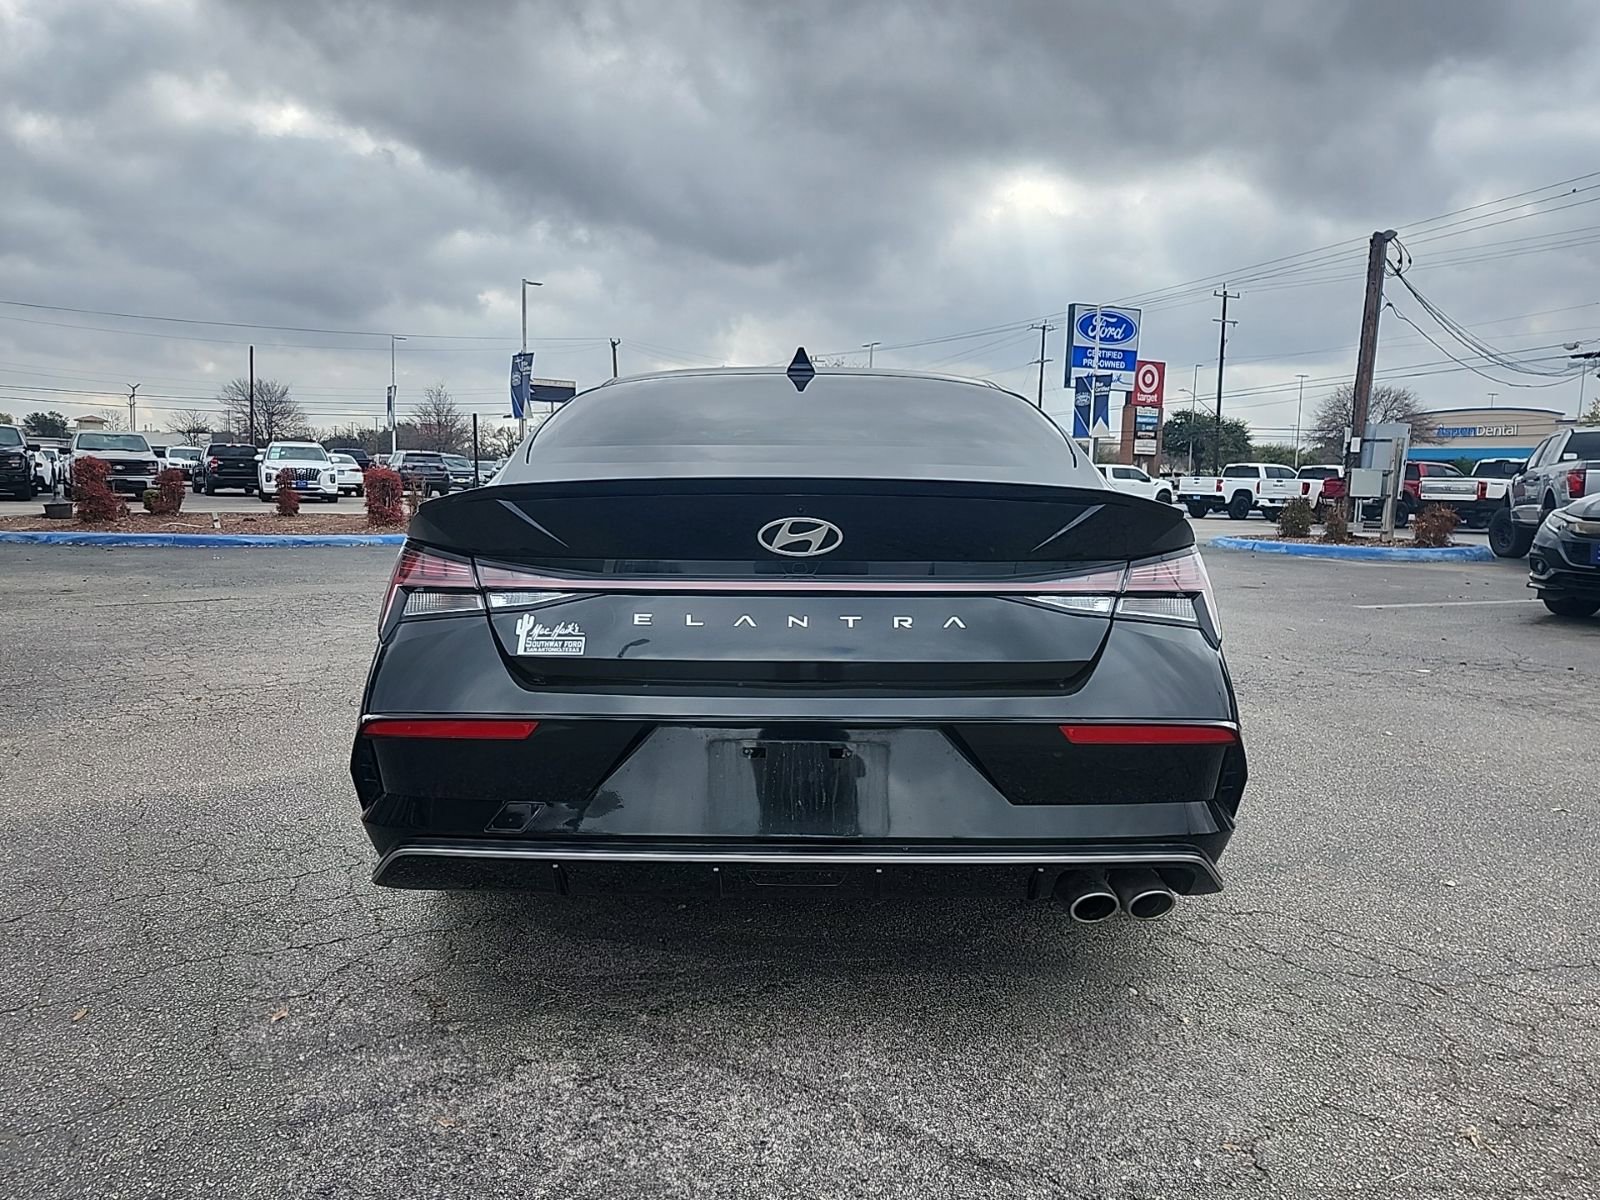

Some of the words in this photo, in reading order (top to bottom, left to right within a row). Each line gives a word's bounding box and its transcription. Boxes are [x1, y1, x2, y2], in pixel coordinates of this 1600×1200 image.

[1088, 315, 1126, 339] Ford
[1137, 393, 1158, 403] target
[633, 613, 966, 629] ELANTRA
[526, 637, 563, 648] SOUTHWAY
[563, 640, 582, 648] FORD
